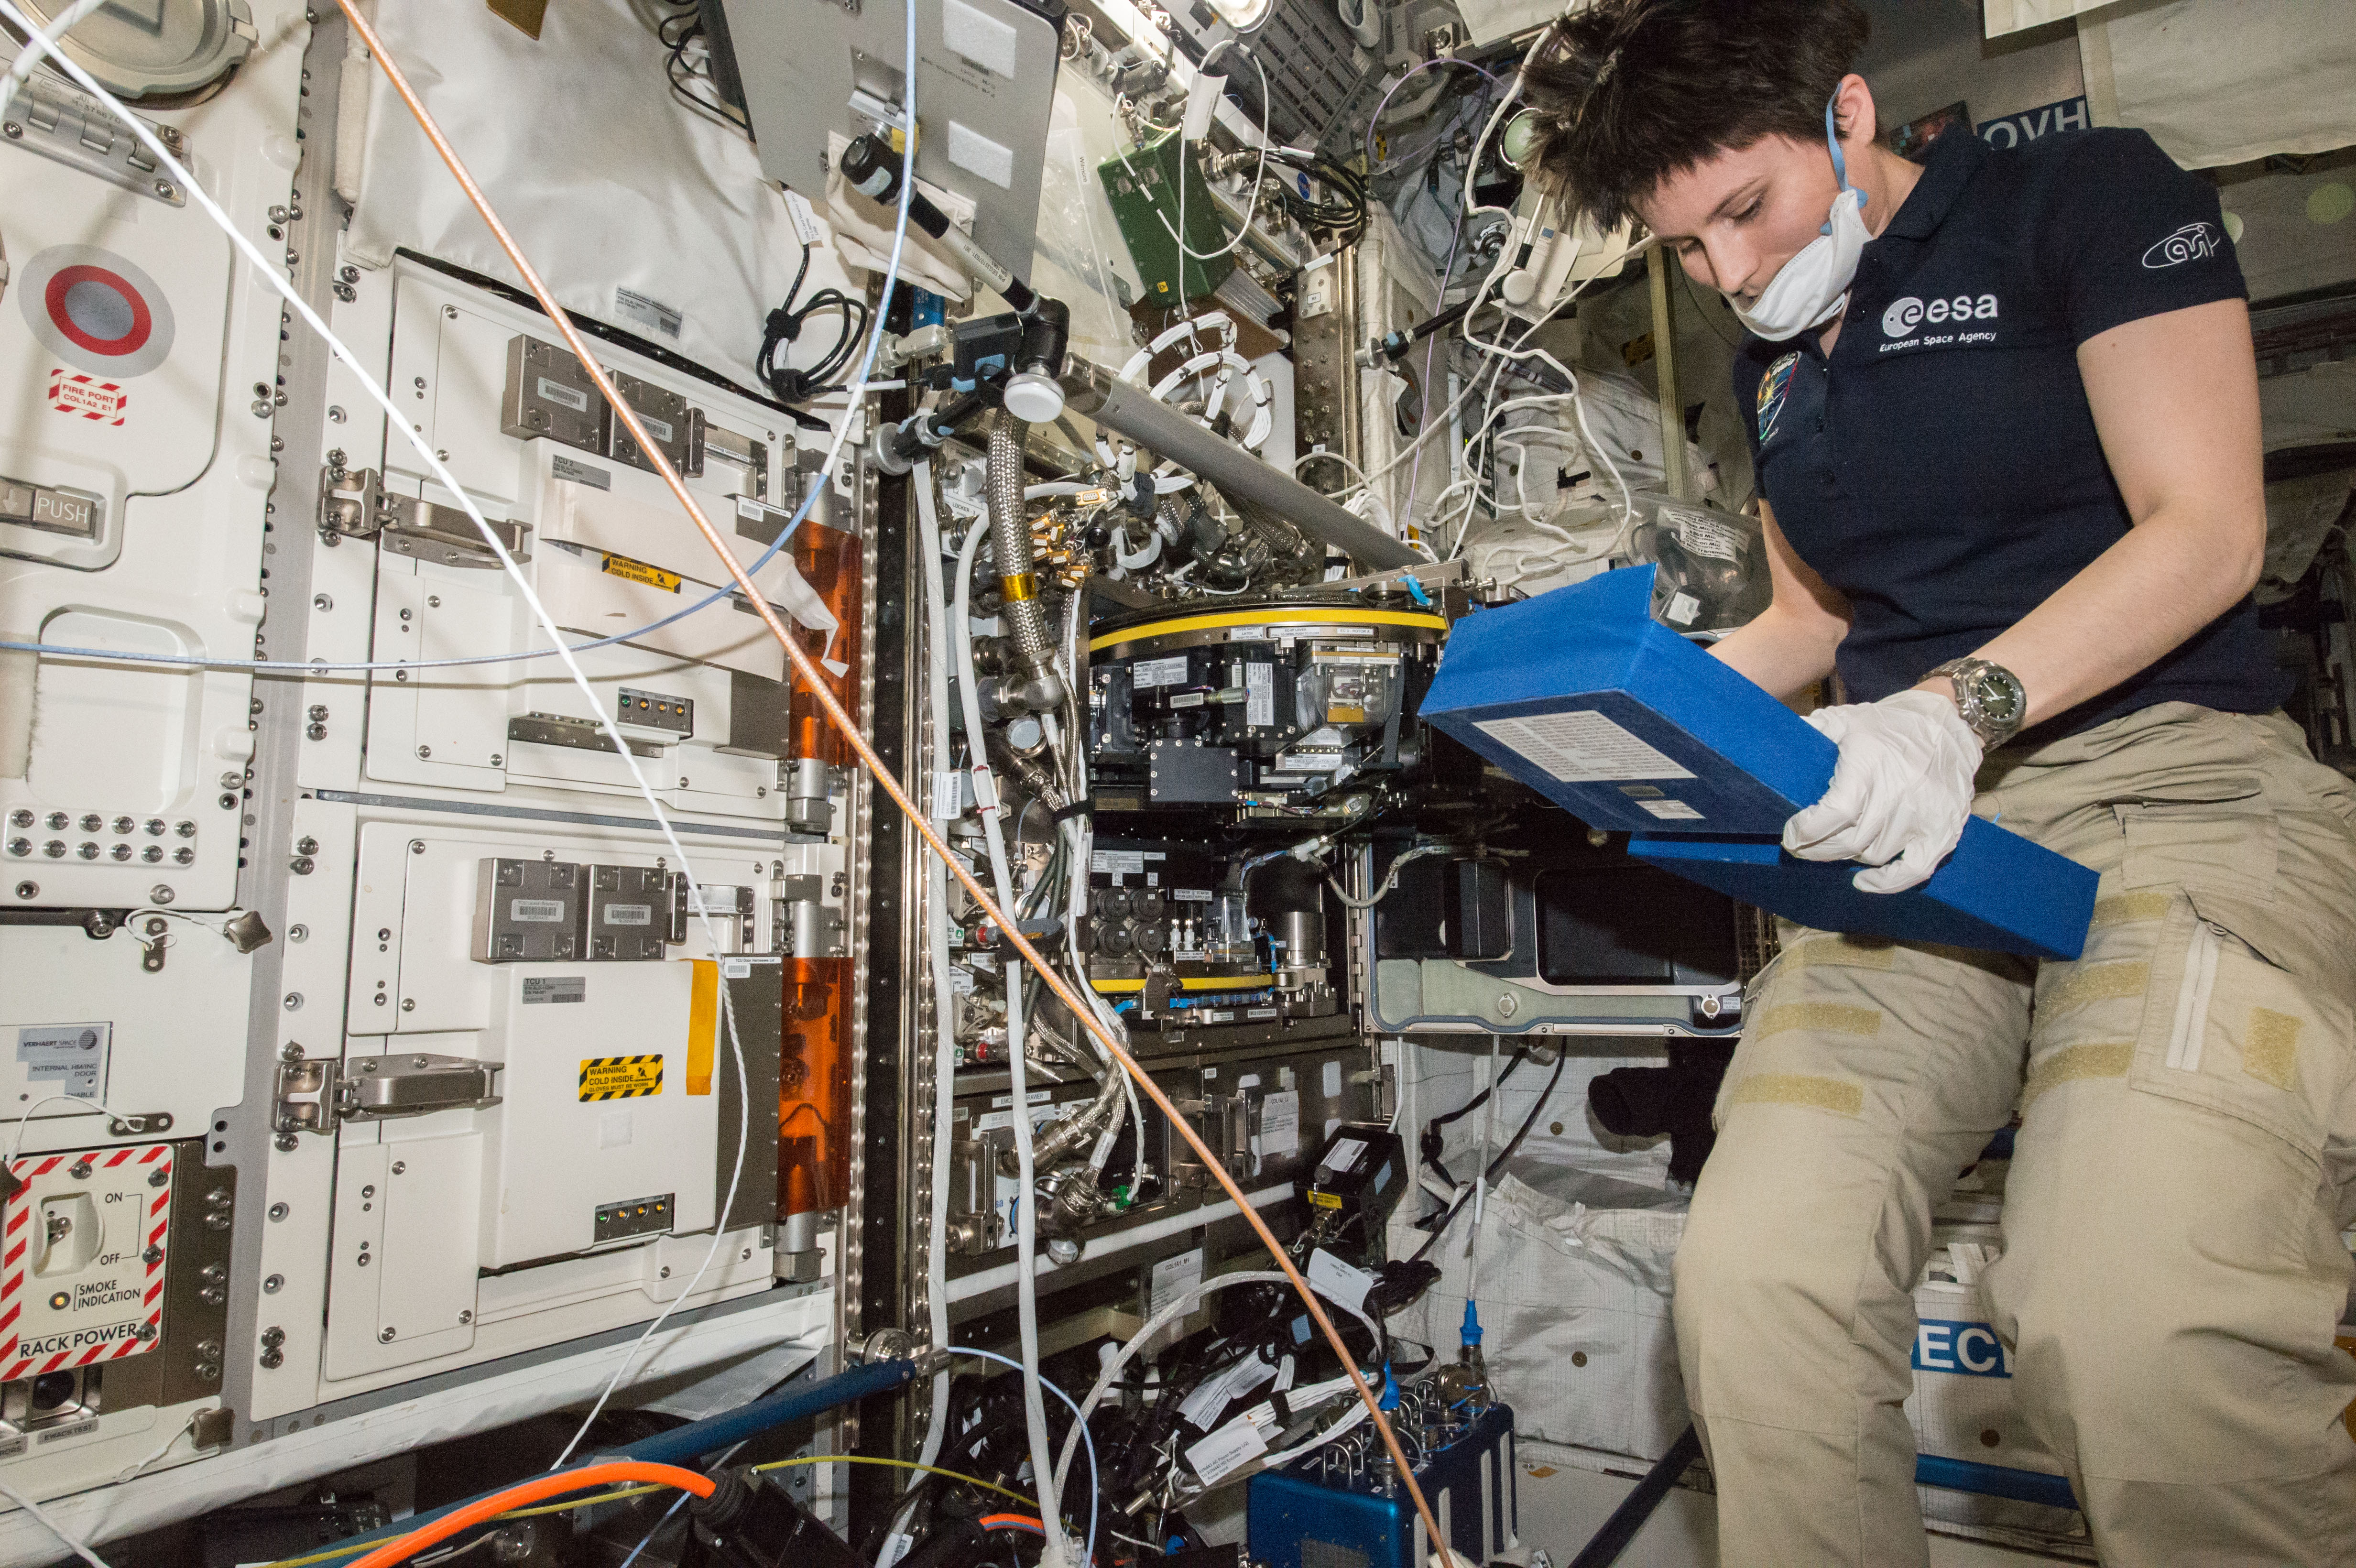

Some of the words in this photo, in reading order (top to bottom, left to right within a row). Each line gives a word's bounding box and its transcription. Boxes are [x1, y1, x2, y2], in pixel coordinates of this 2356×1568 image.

[1926, 294, 1998, 323] esa
[1879, 338, 1919, 352] European
[1923, 335, 1954, 346] Space
[1958, 332, 1996, 343] Agency
[63, 384, 85, 396] FIRE
[88, 391, 115, 404] PORT
[555, 455, 568, 465] TCU
[37, 497, 88, 524] PUSH
[952, 502, 970, 512] LOCKER
[1698, 548, 1733, 558] Transmitter
[611, 559, 647, 574] WARNING
[611, 567, 630, 578] COLD
[632, 573, 654, 584] INSIDE
[589, 1066, 627, 1076] WARNING
[589, 1078, 609, 1086] COLD
[611, 1075, 634, 1084] INSIDE
[105, 1192, 122, 1203] ON
[100, 1253, 120, 1265] OFF
[80, 1280, 117, 1296] SMOKE
[78, 1288, 141, 1308] INDICATION
[20, 1336, 69, 1358] RACK
[74, 1323, 137, 1346] POWER
[1218, 1454, 1229, 1462] Power
[1229, 1446, 1242, 1455] Supply
[1227, 1453, 1241, 1463] Encoder
